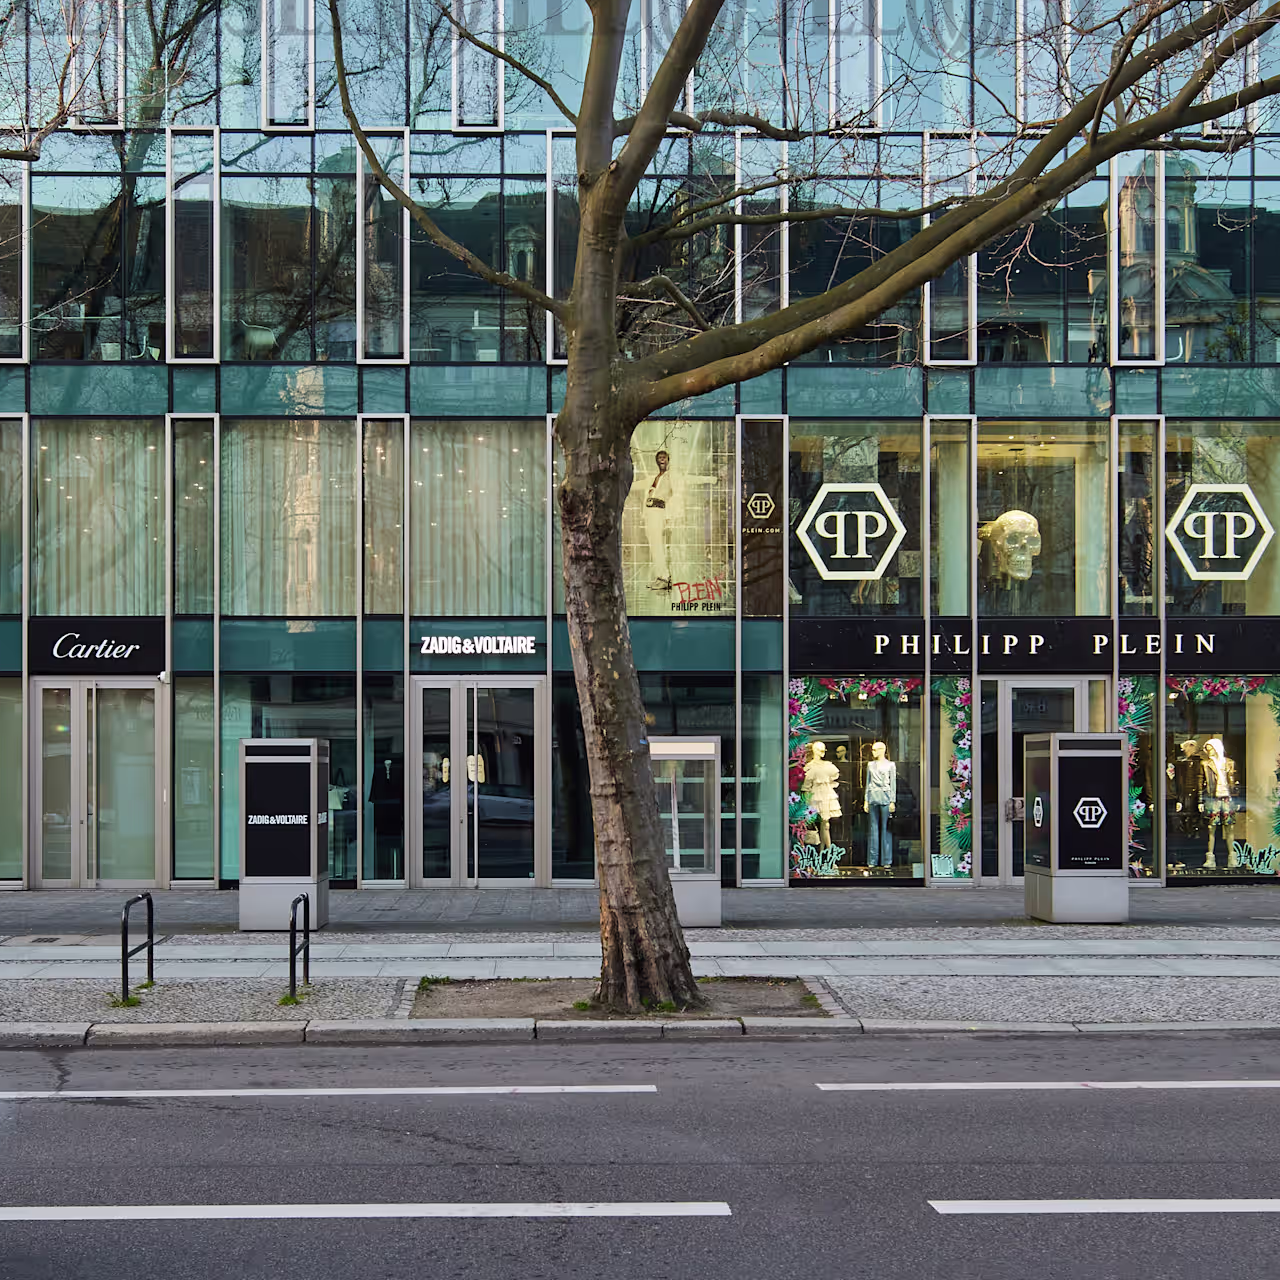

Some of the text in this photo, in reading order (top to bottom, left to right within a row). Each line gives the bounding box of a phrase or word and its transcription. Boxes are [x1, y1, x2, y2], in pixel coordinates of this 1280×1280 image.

[672, 603, 720, 611] PHILIPP PLEIN
[52, 632, 140, 658] Cartier
[421, 636, 536, 654] ZADIG&VOLTAIRE
[874, 634, 1216, 654] PHILIPP PLEIN
[248, 815, 308, 824] ZADIG&VOLTAIRE
